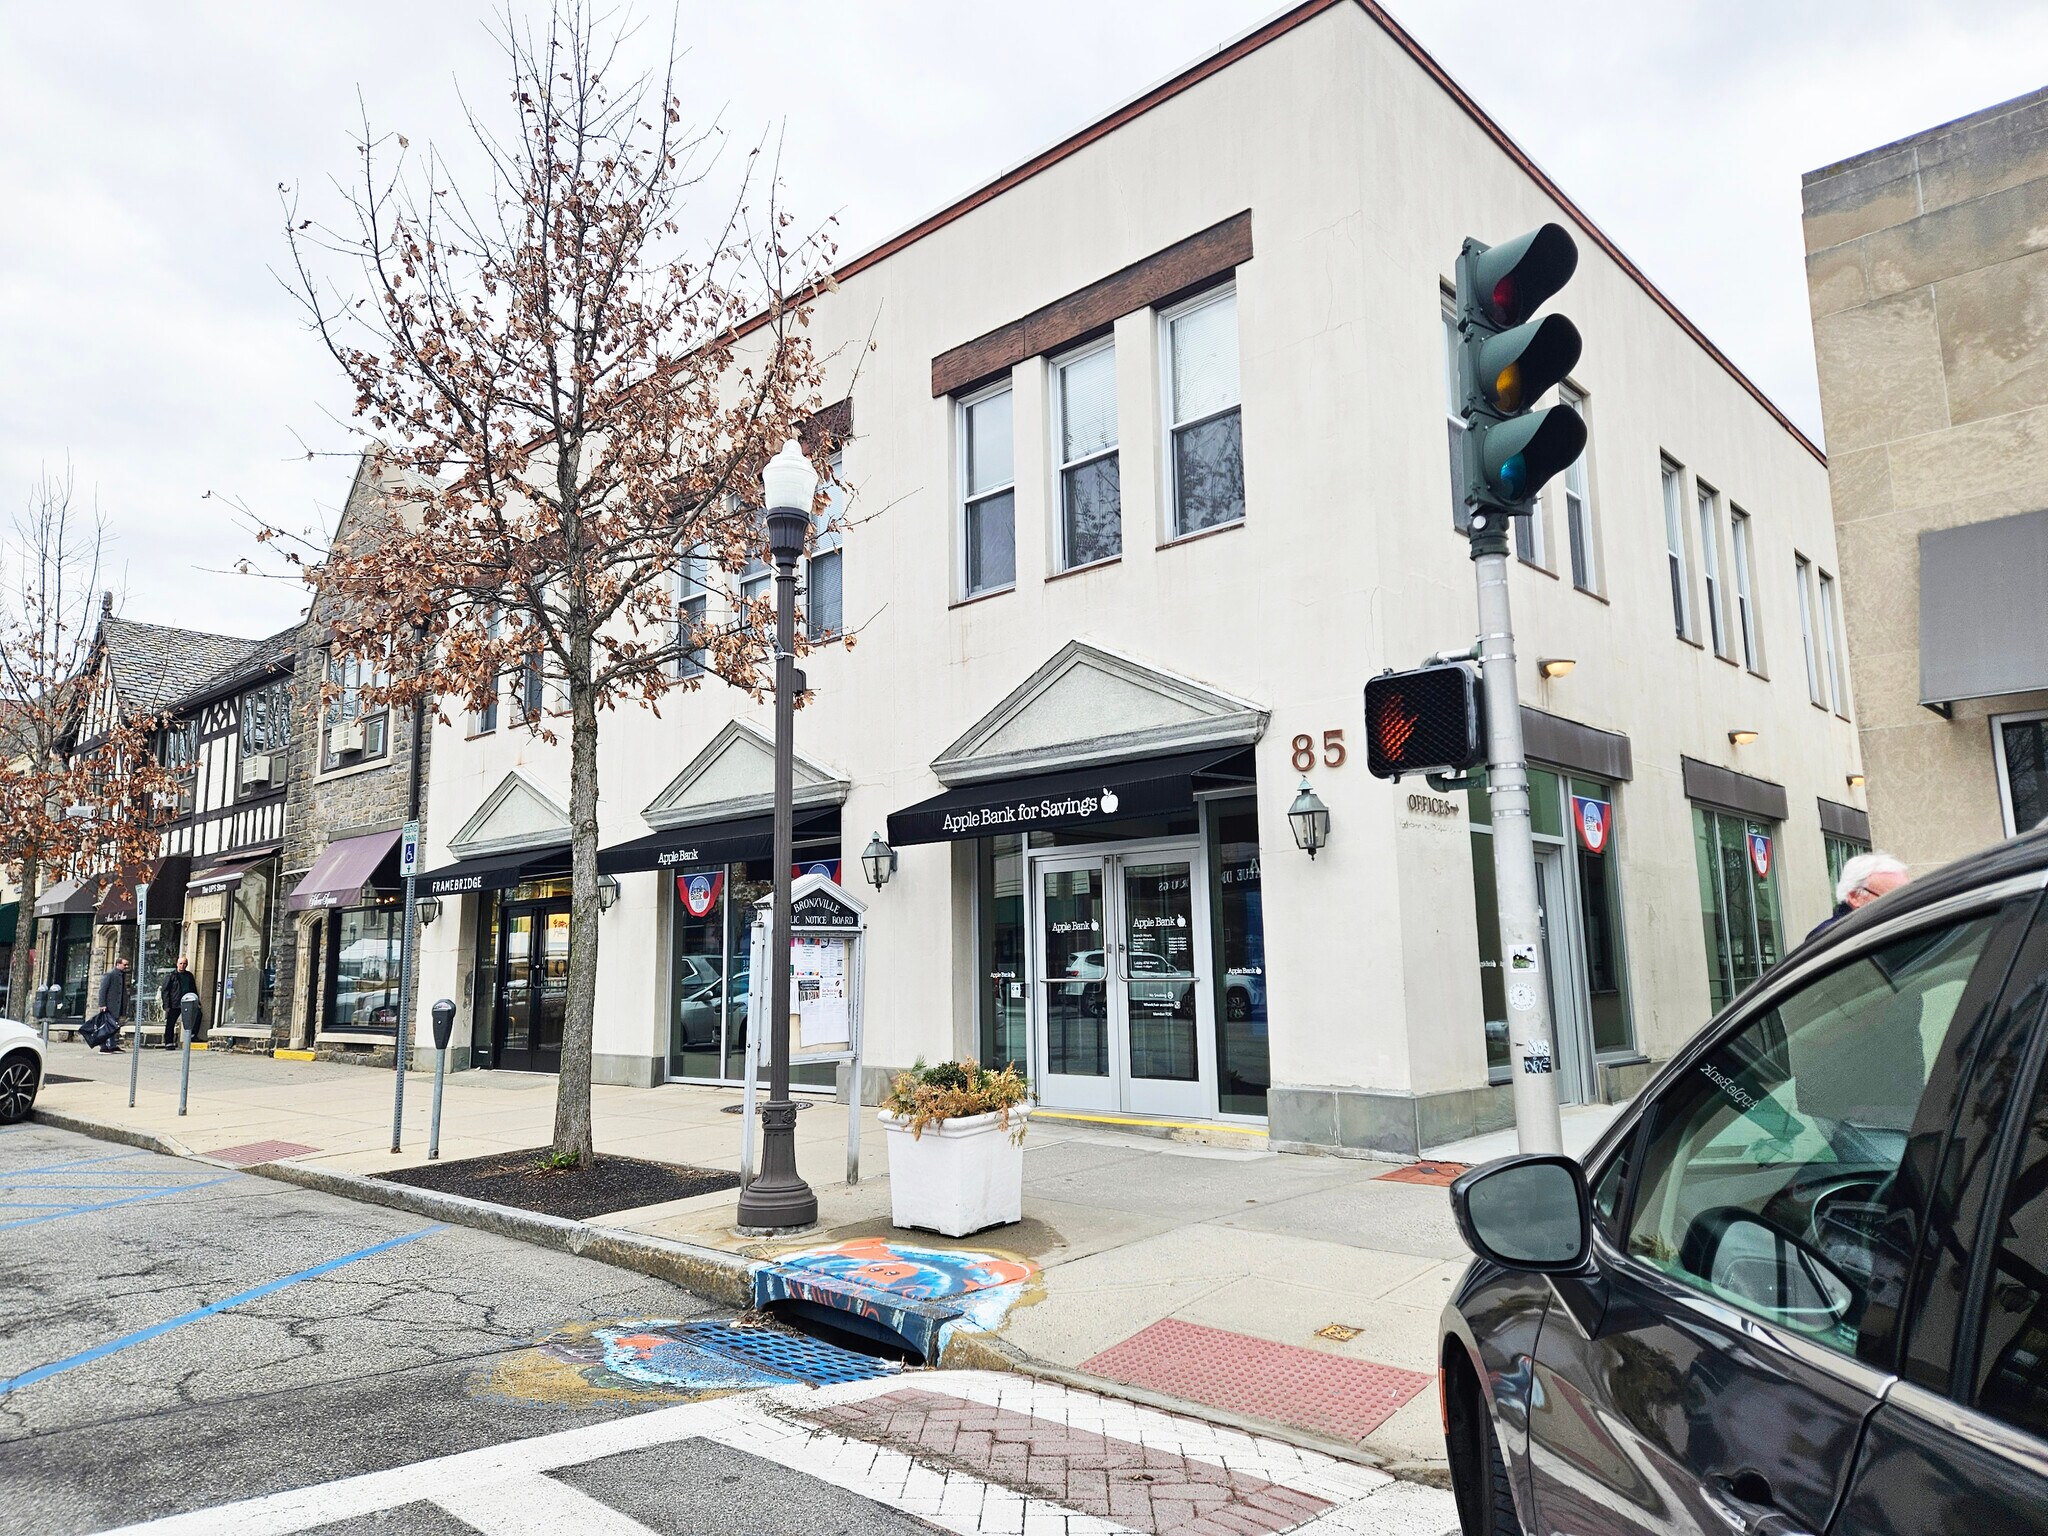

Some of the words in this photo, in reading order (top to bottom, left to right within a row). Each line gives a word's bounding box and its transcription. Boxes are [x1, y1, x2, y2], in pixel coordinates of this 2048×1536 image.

[1291, 729, 1346, 772] 85
[1408, 794, 1451, 816] OFFICES
[942, 811, 980, 833] Apple
[980, 806, 1016, 826] Bank
[1017, 803, 1039, 821] for
[1040, 796, 1098, 817] Savings
[657, 850, 679, 866] Apple
[679, 848, 698, 862] Bank
[201, 886, 209, 895] The
[209, 884, 217, 893] UPS
[216, 883, 227, 892] Store
[431, 876, 482, 893] FRAMEBRIDGE
[793, 897, 841, 915] BRONXVILLE
[805, 915, 828, 925] NOTICE
[832, 915, 854, 926] BOARD
[1052, 922, 1072, 934] Apple
[1072, 920, 1090, 931] Bank
[1133, 918, 1155, 929] Apple
[1155, 916, 1176, 927] Bank
[1227, 967, 1242, 976] Apple
[1242, 967, 1256, 975] Bank
